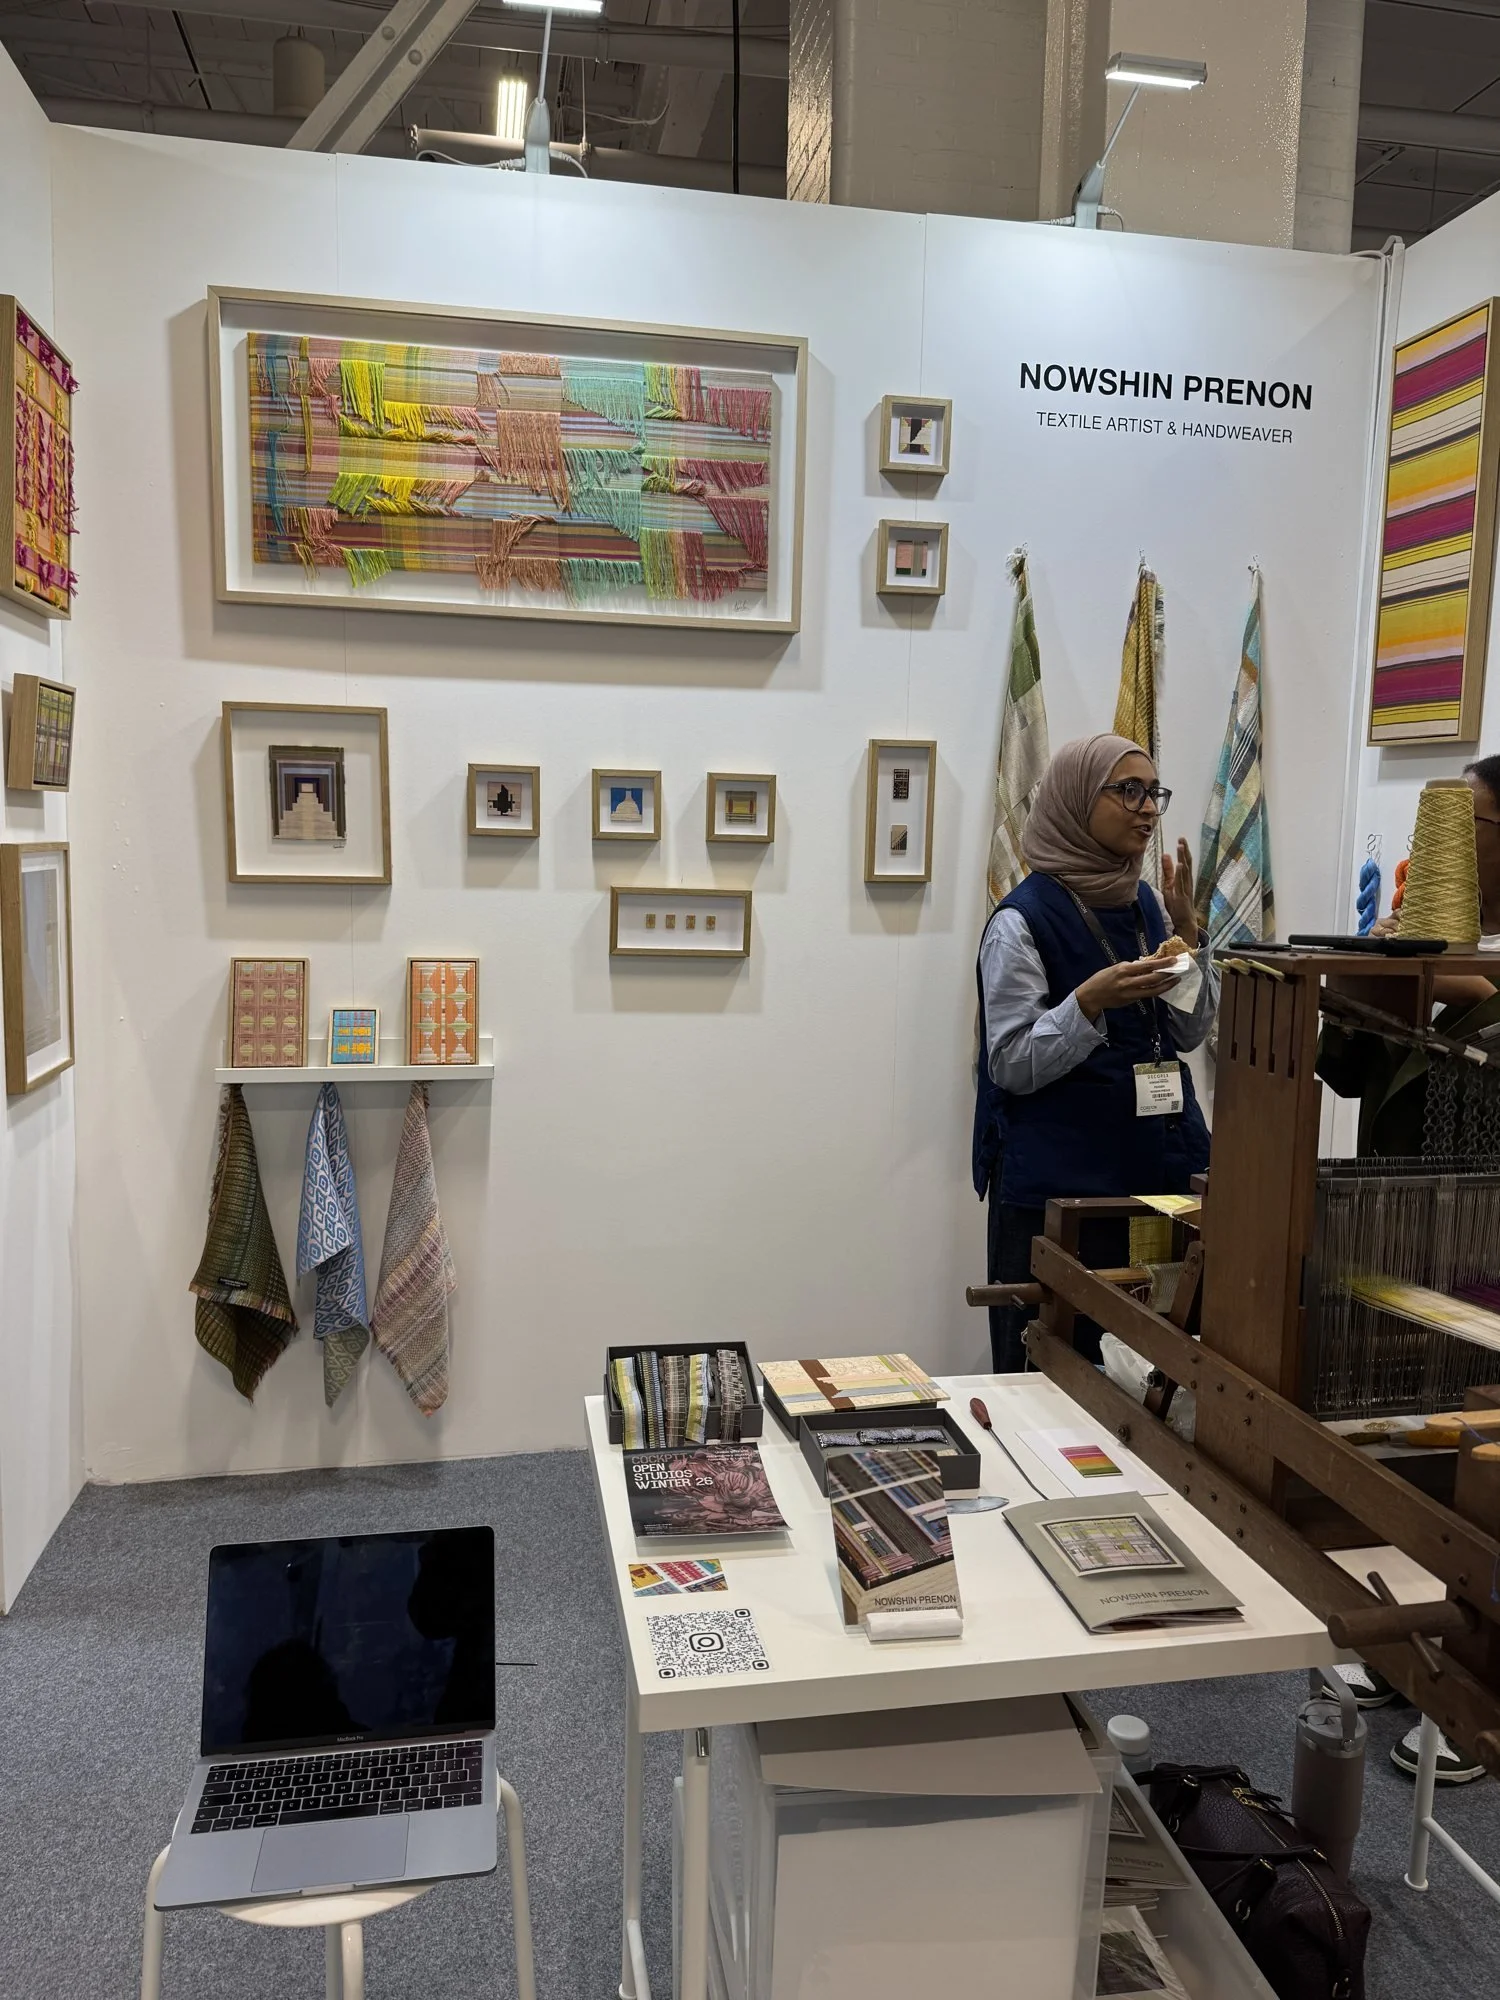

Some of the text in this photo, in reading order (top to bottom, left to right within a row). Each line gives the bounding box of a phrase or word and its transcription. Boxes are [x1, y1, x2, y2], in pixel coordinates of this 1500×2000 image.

[1020, 362, 1313, 410] NOWSHIN PRENON
[1036, 411, 1293, 444] TEXTILE ARTIST & HANDWEAVER
[632, 1462, 666, 1473] OPEN
[633, 1469, 693, 1482] STUDIOS
[635, 1476, 714, 1490] WINTER 26
[874, 1594, 957, 1606] NOWSHIN PRENON
[1099, 1591, 1158, 1605] NOWSHIN
[1159, 1589, 1210, 1598] PRENON
